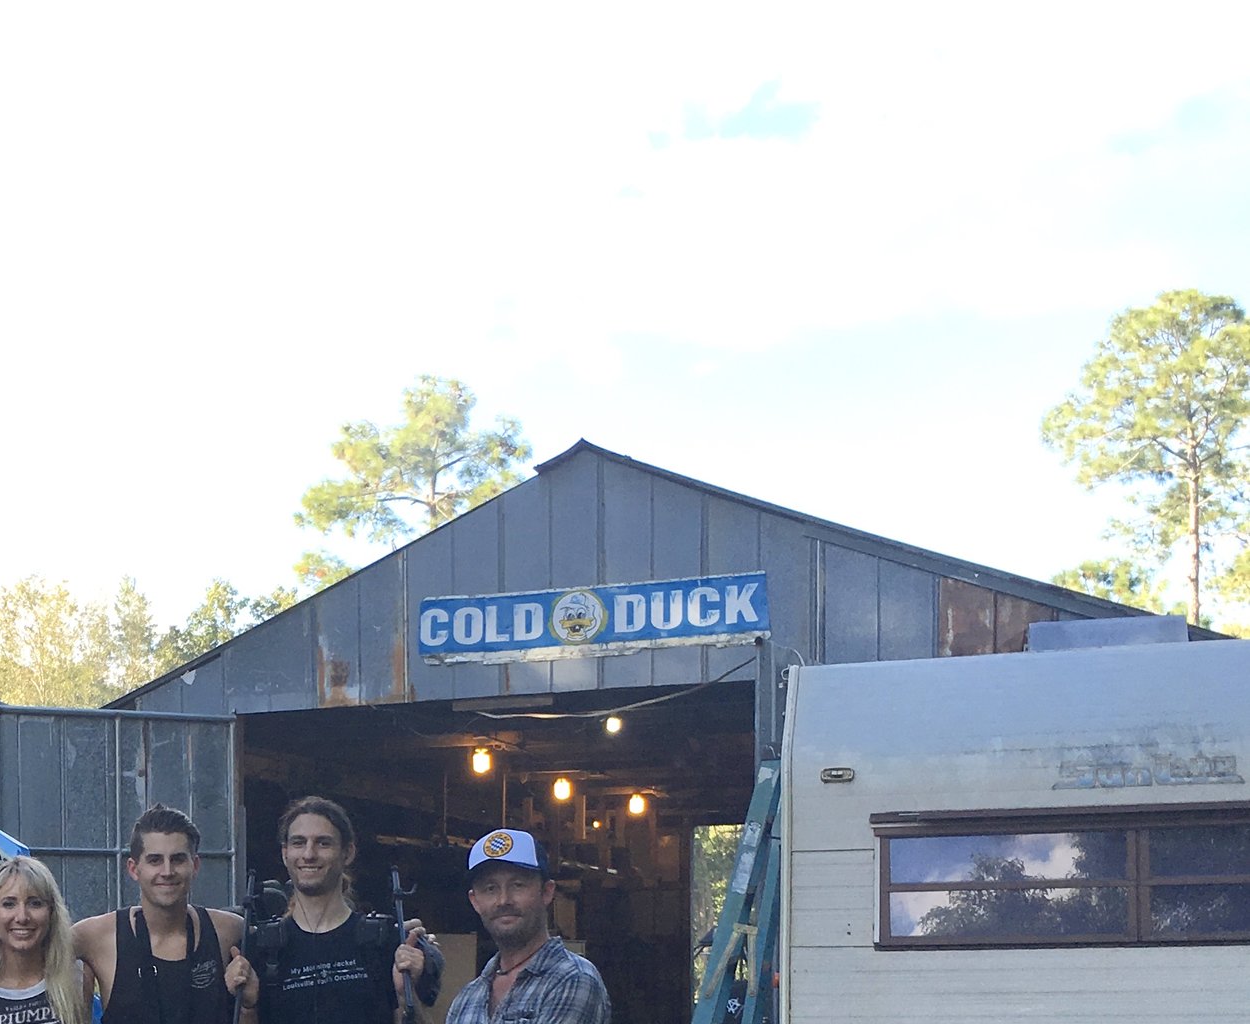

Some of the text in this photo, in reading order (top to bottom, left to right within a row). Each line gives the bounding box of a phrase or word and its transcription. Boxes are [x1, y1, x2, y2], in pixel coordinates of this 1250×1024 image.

[420, 583, 759, 646] COLD DUCK
[290, 967, 301, 975] My
[333, 959, 356, 968] Jacket
[282, 980, 314, 991] Louisville
[334, 972, 368, 982] Orchestra
